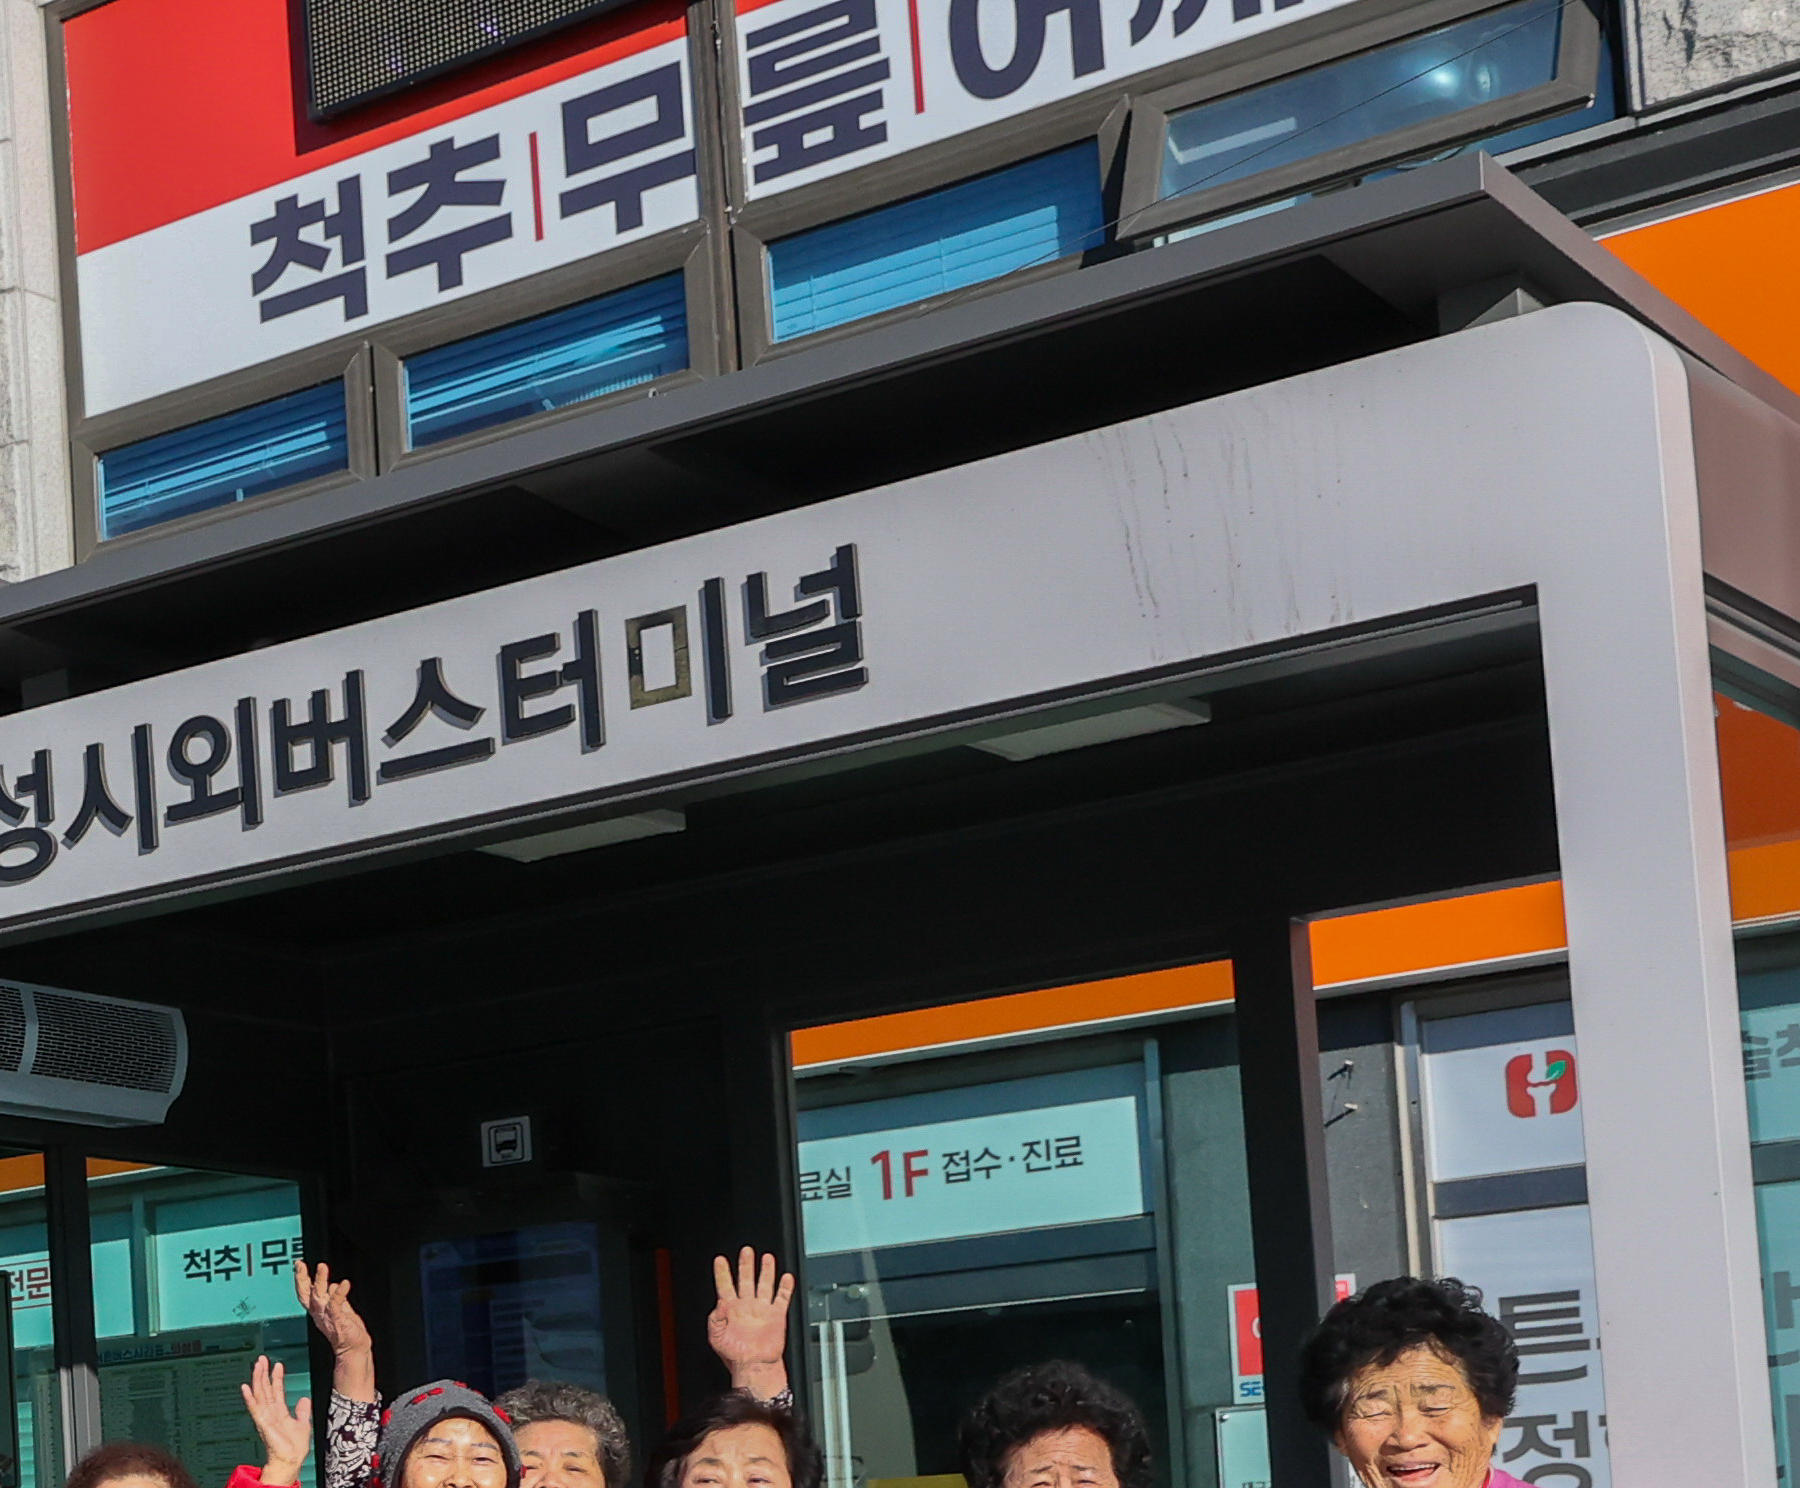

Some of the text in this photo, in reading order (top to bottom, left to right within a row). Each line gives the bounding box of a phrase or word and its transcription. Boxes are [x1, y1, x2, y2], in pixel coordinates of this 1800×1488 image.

[248, 130, 515, 324] 척추
[870, 1147, 930, 1200] 1F
[183, 1245, 242, 1284] 척추
